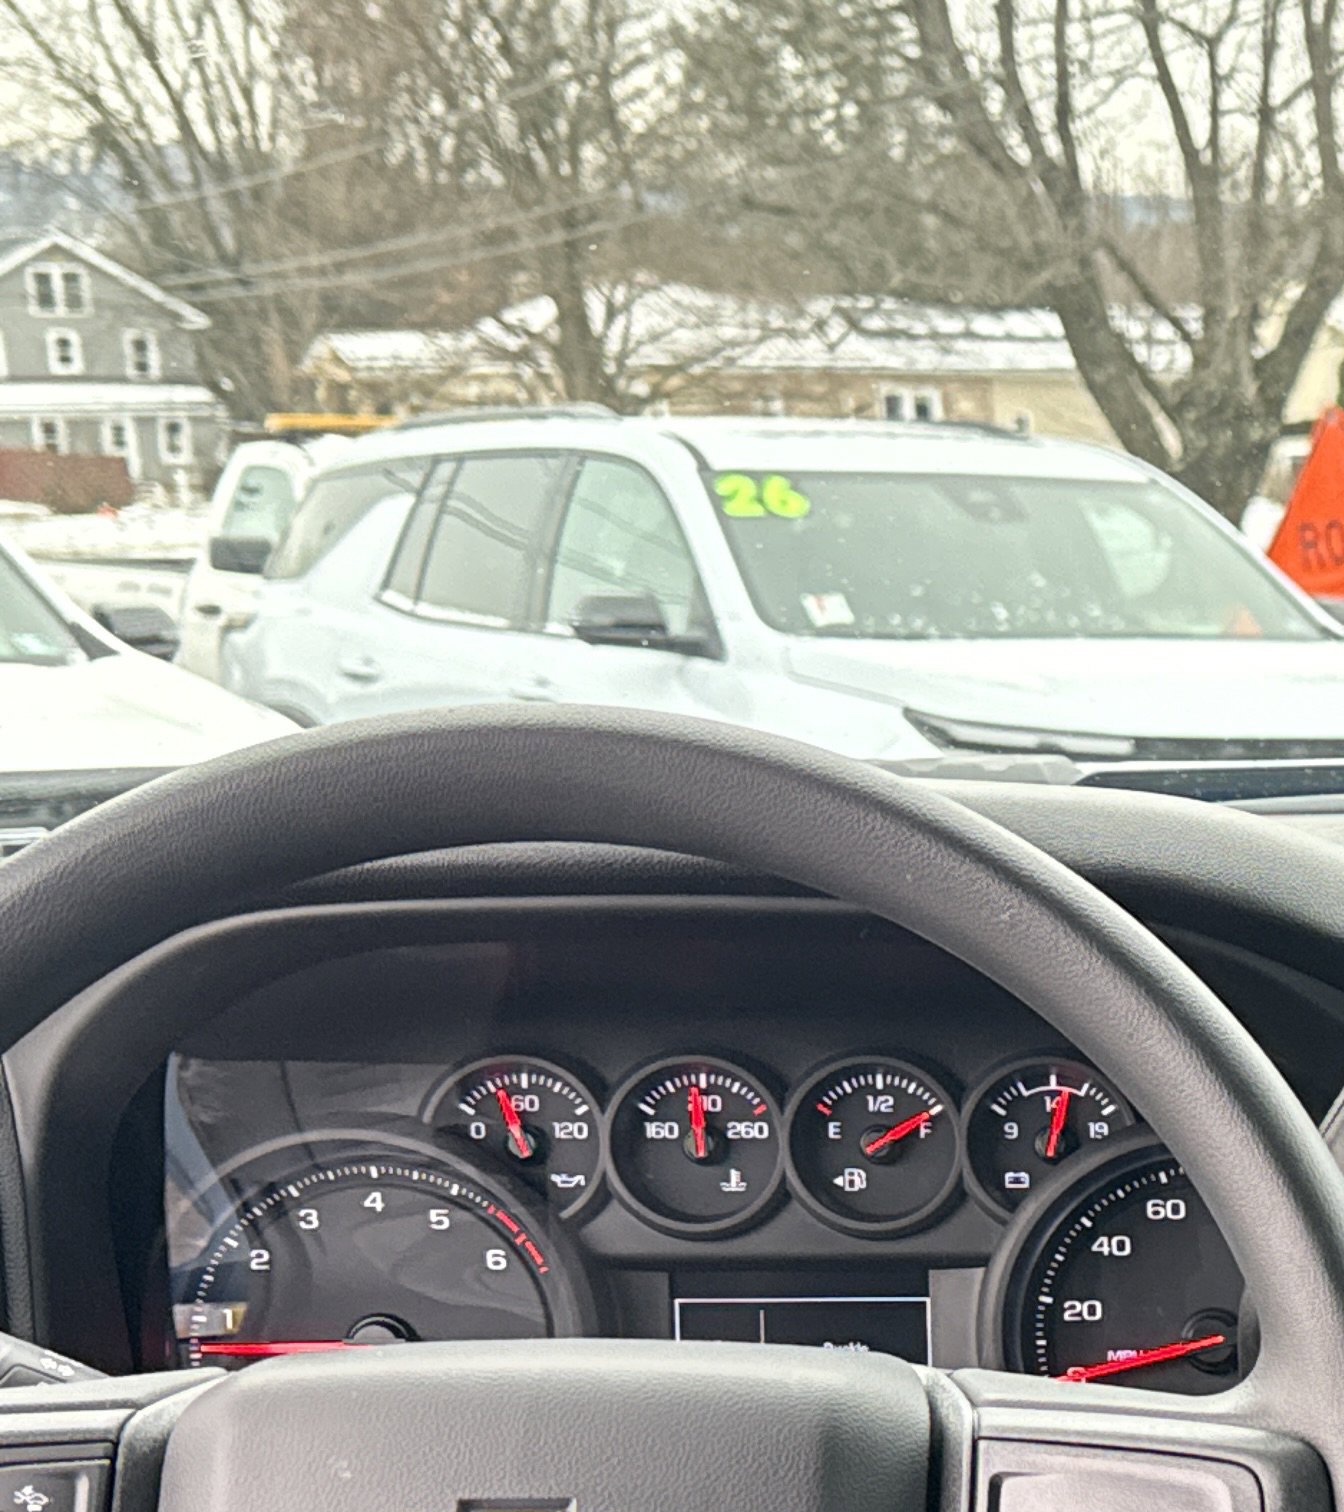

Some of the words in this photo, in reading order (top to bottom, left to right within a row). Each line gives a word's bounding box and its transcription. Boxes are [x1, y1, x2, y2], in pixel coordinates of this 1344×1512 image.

[714, 473, 811, 518] 26
[512, 1095, 540, 1112] 60
[866, 1095, 894, 1112] 1/2
[470, 1122, 486, 1140] 0
[553, 1122, 589, 1140] 120
[644, 1121, 679, 1139] 160
[727, 1121, 769, 1139] 260
[827, 1122, 842, 1139] E
[919, 1121, 933, 1138] F
[1003, 1122, 1019, 1139] 9
[1087, 1122, 1109, 1139] 19
[363, 1192, 385, 1212] 4
[1146, 1199, 1186, 1219] 60
[298, 1209, 320, 1231] 3
[429, 1209, 451, 1230] 5
[1092, 1236, 1132, 1256] 40
[249, 1249, 271, 1270] 2
[485, 1249, 508, 1270] 6
[223, 1308, 235, 1329] 1
[1063, 1300, 1102, 1320] 20
